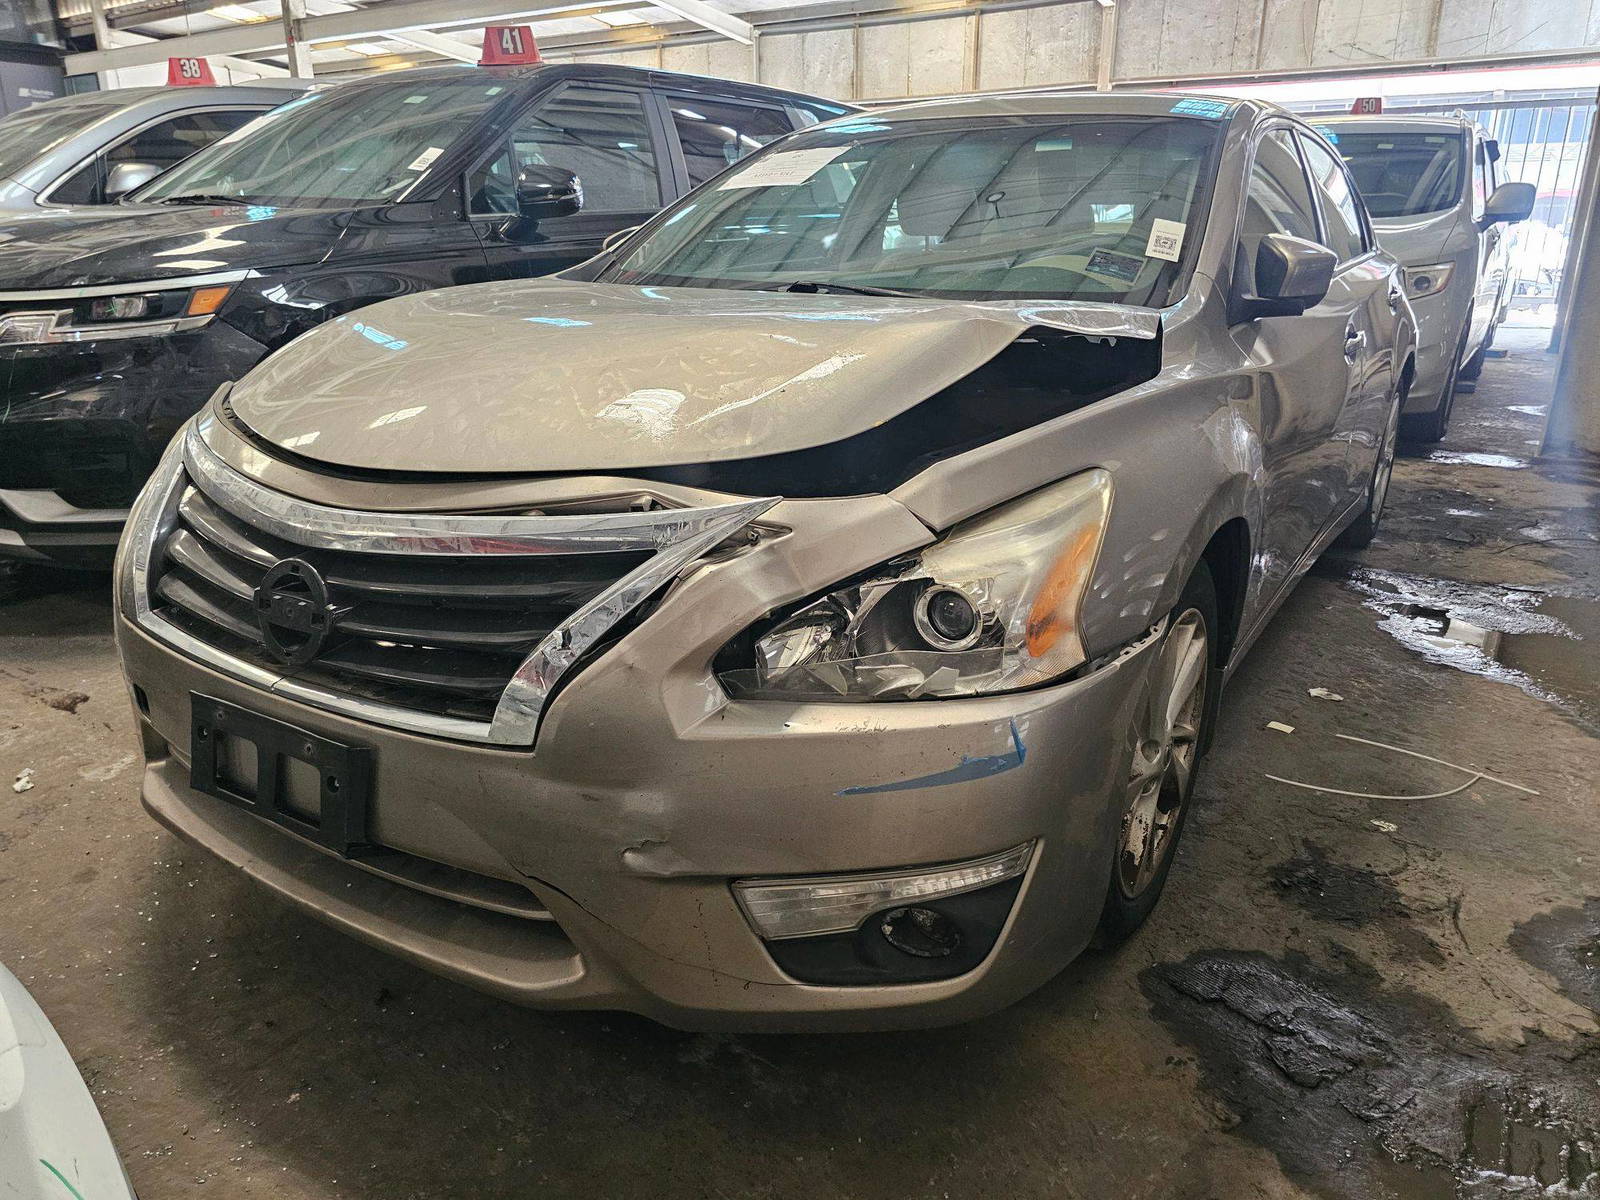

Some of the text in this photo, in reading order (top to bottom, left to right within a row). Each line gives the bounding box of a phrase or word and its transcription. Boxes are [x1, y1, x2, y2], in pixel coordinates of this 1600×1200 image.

[502, 28, 524, 54] 41
[180, 59, 201, 78] 38
[1362, 99, 1376, 113] 50
